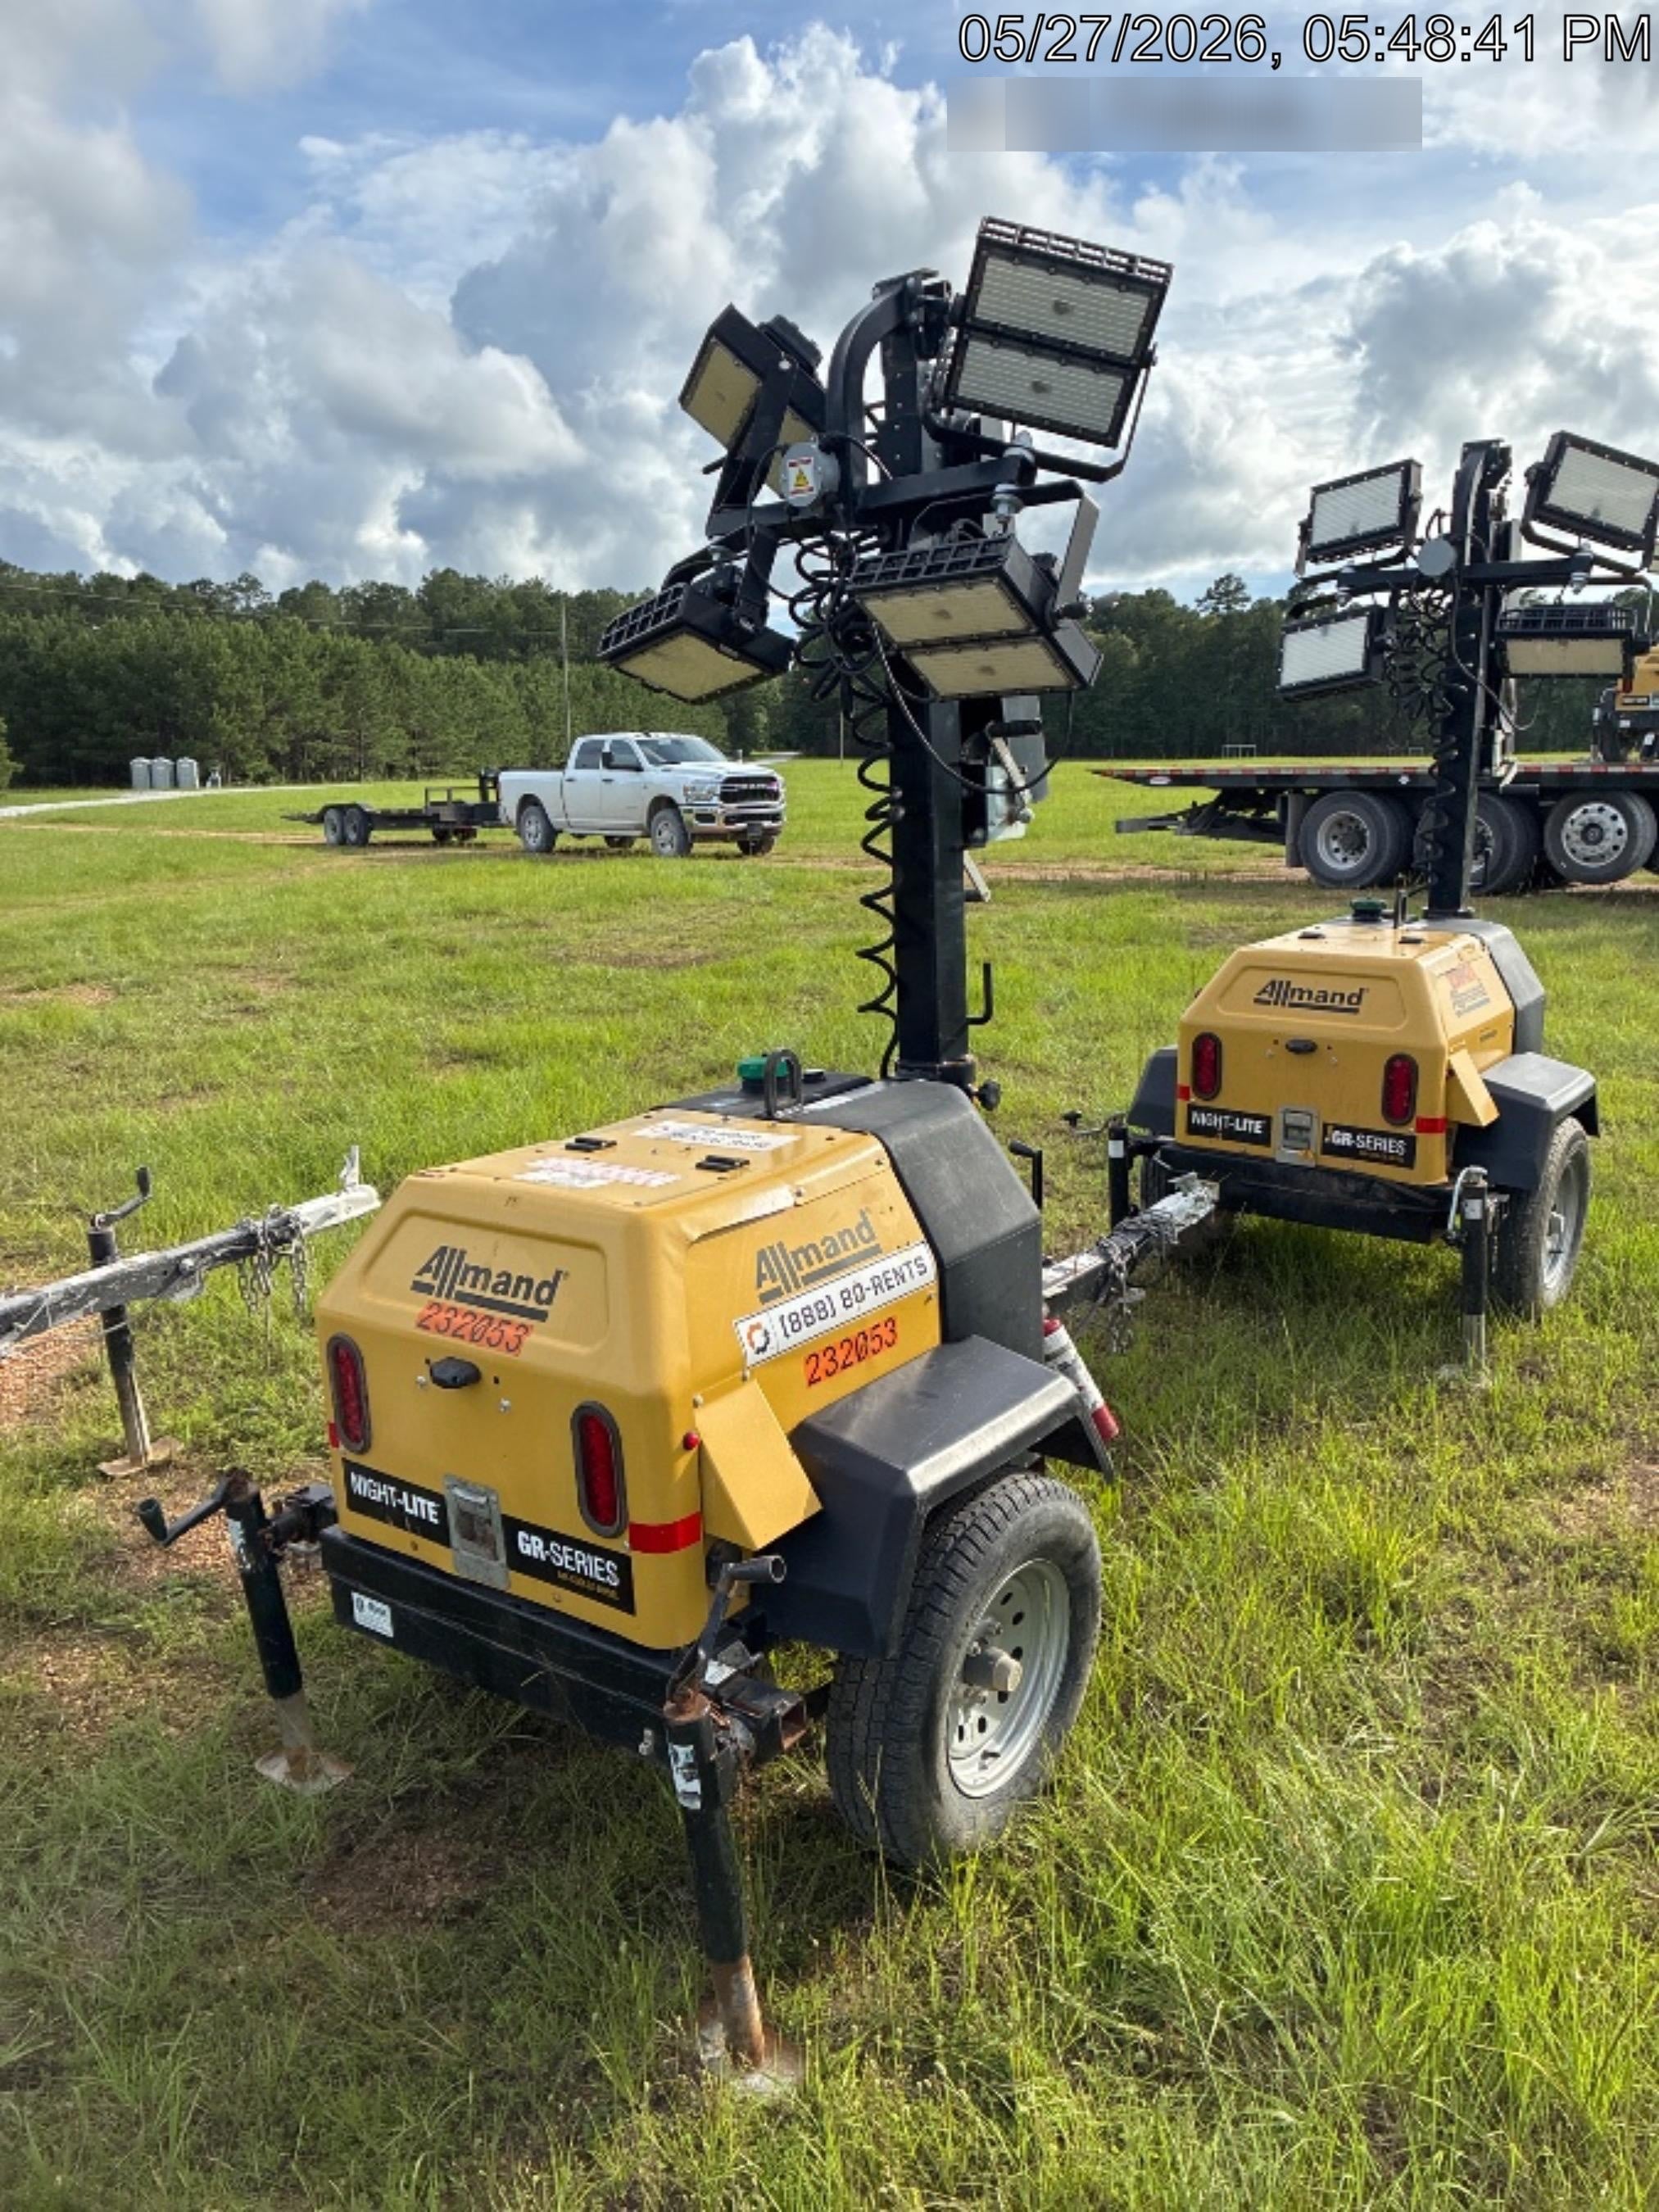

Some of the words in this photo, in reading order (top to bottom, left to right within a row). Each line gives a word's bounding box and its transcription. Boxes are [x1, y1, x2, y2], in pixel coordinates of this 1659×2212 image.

[1255, 978, 1364, 1006] Allmand
[1191, 1110, 1263, 1134] NIGHT-LITE
[1330, 1129, 1407, 1157] GR-SERIES
[414, 1244, 564, 1306] Allmand
[756, 1208, 877, 1294] Allmand
[840, 1255, 927, 1309] 80-RENTS
[416, 1301, 531, 1353] 232053
[805, 1316, 898, 1386] 232053
[350, 1471, 441, 1525] NIGHT-LITE
[517, 1530, 620, 1588] GR-SERIES
